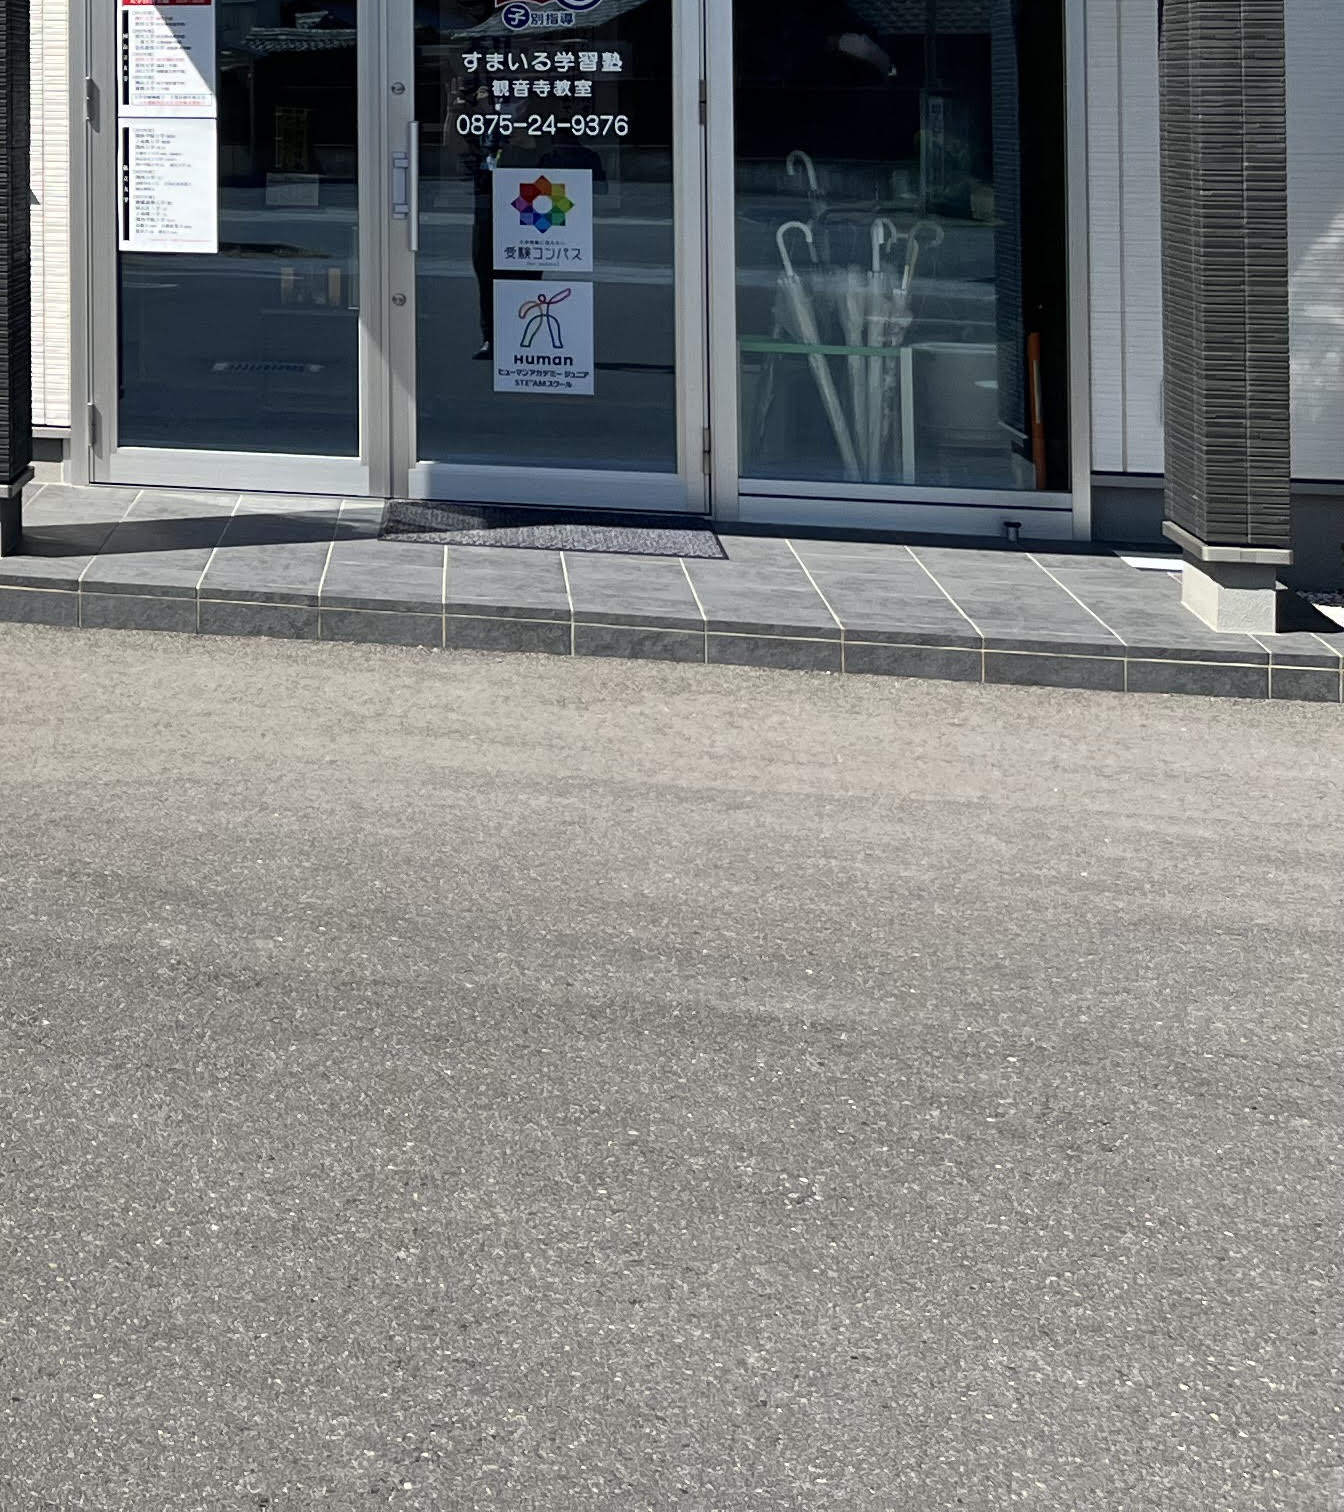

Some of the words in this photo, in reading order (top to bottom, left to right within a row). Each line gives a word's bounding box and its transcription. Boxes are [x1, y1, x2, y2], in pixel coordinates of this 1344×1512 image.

[462, 51, 623, 73] すまいる学習塾
[491, 79, 593, 97] 観音寺教室
[456, 114, 629, 136] 0875-24-9376
[504, 246, 583, 261] 受験コンパス
[514, 354, 574, 366] Human
